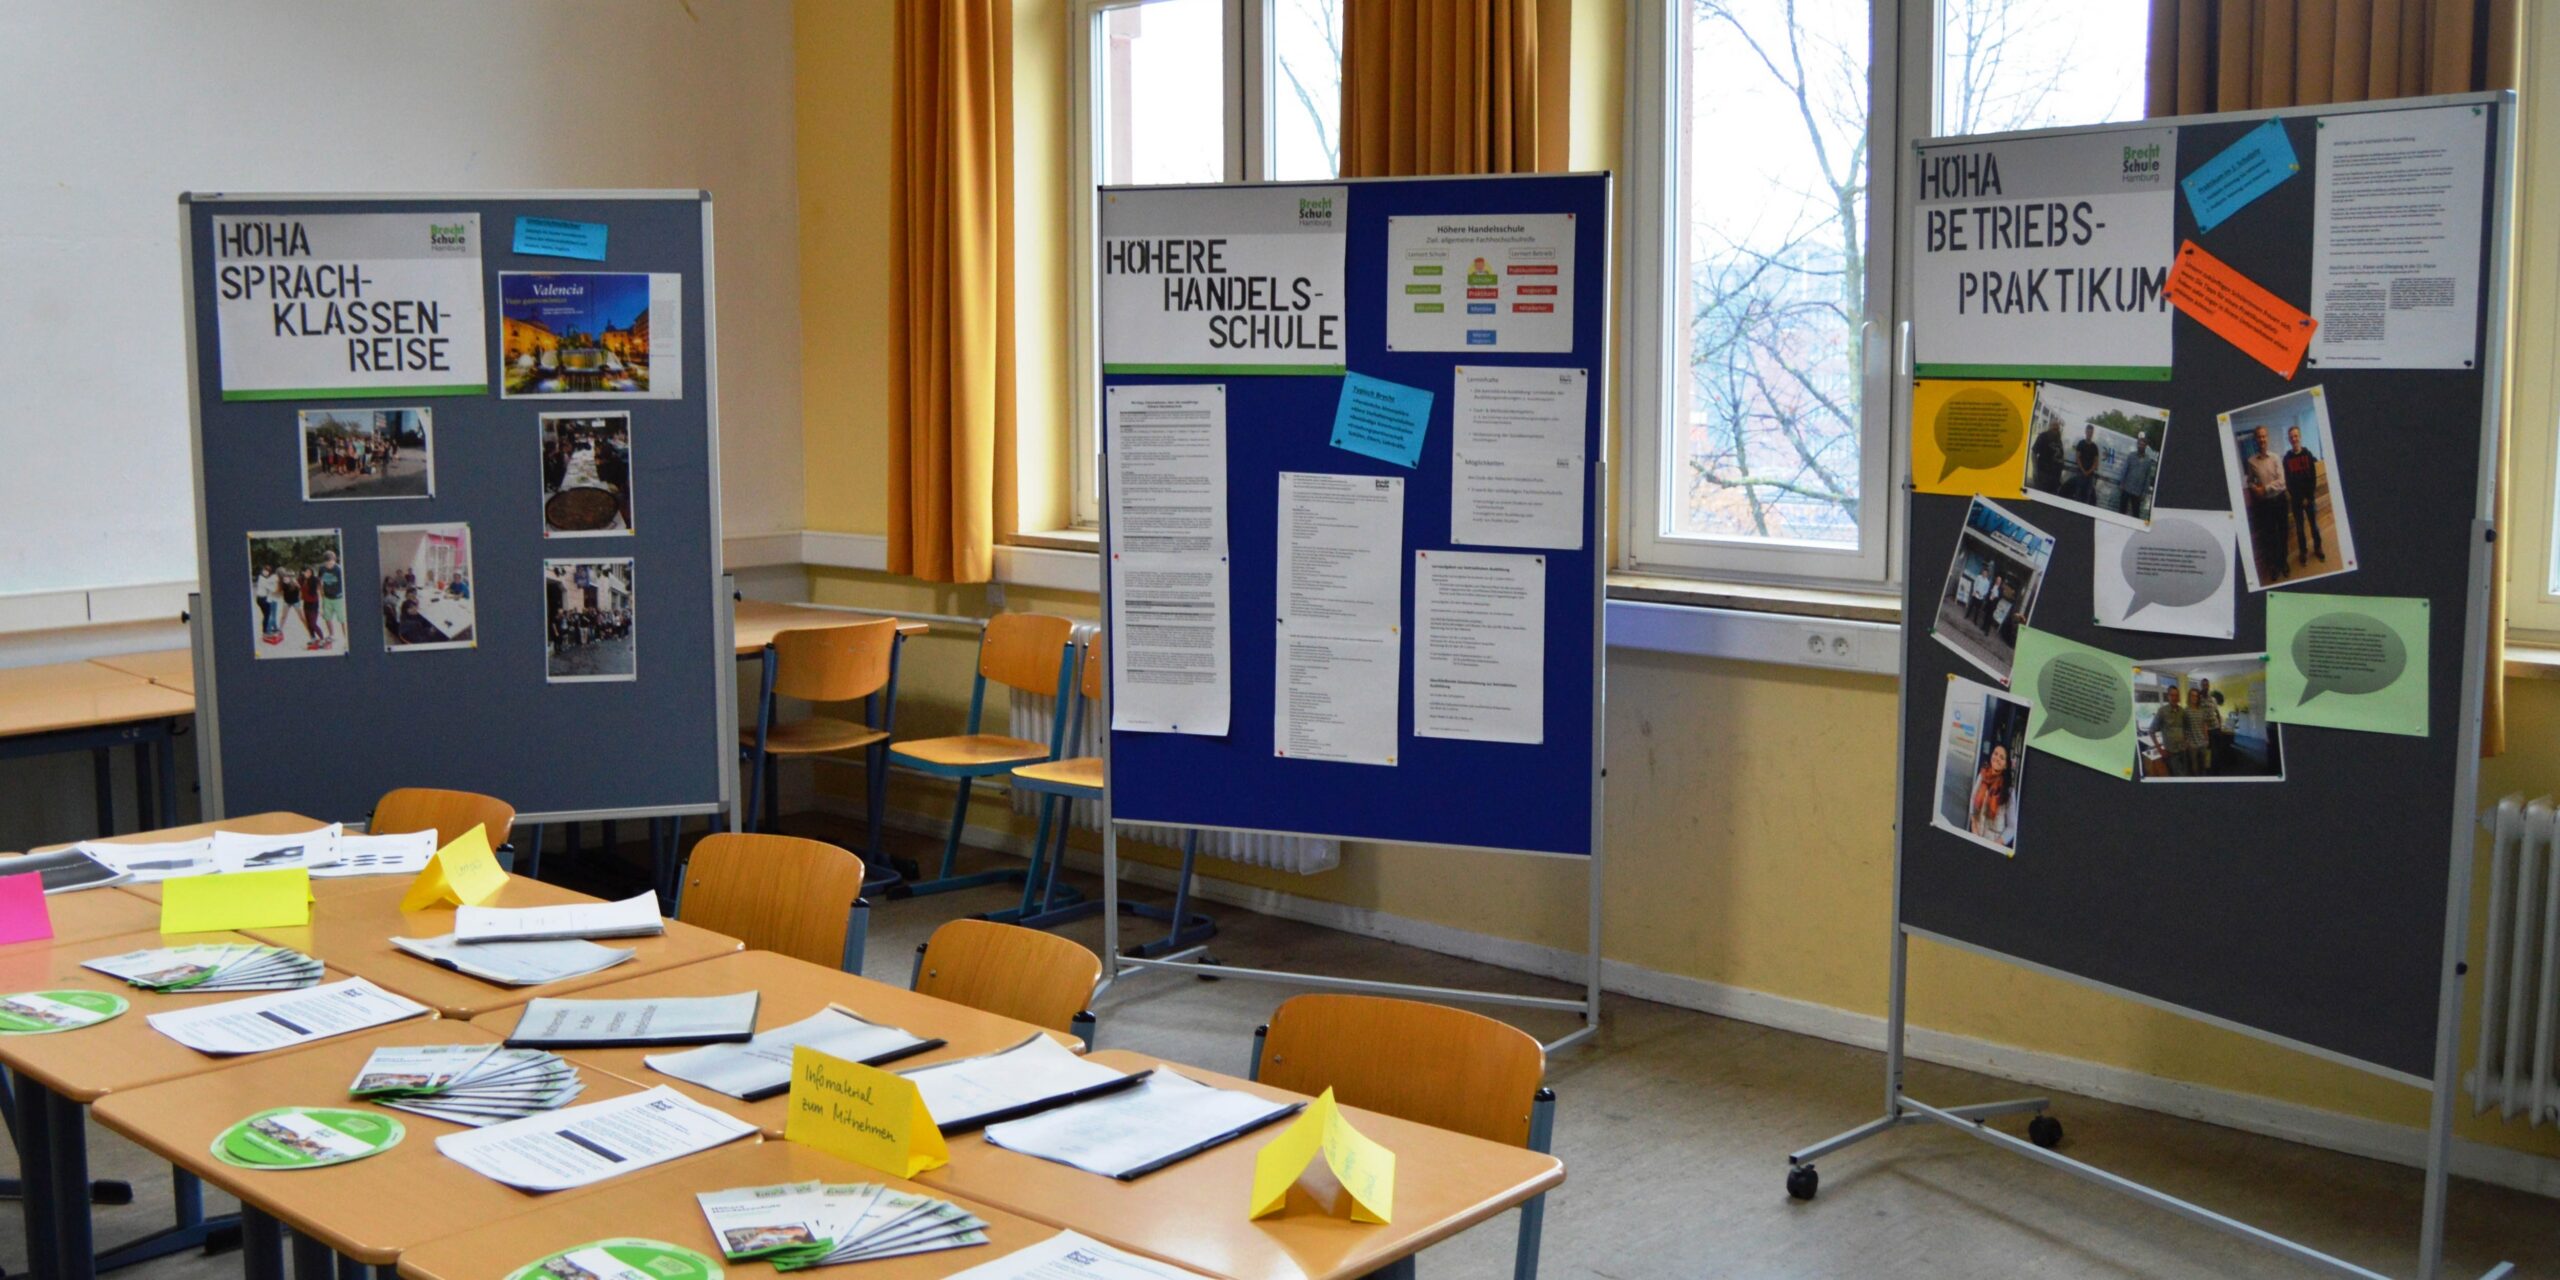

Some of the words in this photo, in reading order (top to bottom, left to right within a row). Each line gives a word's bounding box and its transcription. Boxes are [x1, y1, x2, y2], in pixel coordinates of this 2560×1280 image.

[2122, 158, 2160, 173] Schule
[2123, 143, 2160, 162] Brecht
[1921, 152, 2001, 199] HÖHA
[2122, 171, 2160, 183] Hamburg
[1300, 197, 1331, 209] Brecht
[1300, 208, 1331, 219] Schule
[431, 223, 465, 236] Brecht
[1300, 218, 1331, 227] Hamburg
[1438, 225, 1465, 233] Höhere
[1468, 225, 1524, 233] Handelsschule
[1928, 201, 2106, 252] BETRIEBS-
[220, 222, 310, 258] HÖHA
[432, 234, 465, 245] Schule
[432, 244, 466, 253] Hamburg
[1107, 238, 1227, 275] HÖHERE
[221, 264, 372, 300] SPRACH-
[533, 284, 584, 296] Valencia
[1165, 277, 1324, 312] HANDELS-
[1959, 266, 2167, 315] PRAKTIKUM
[2202, 283, 2218, 296] Tipps
[274, 300, 451, 337] KLASSEN-
[1209, 315, 1338, 350] SCHULE
[350, 338, 450, 372] REISE
[805, 1064, 873, 1105] Infomaterial
[802, 1098, 823, 1116] zum
[833, 1102, 895, 1142] Mitnehmen
